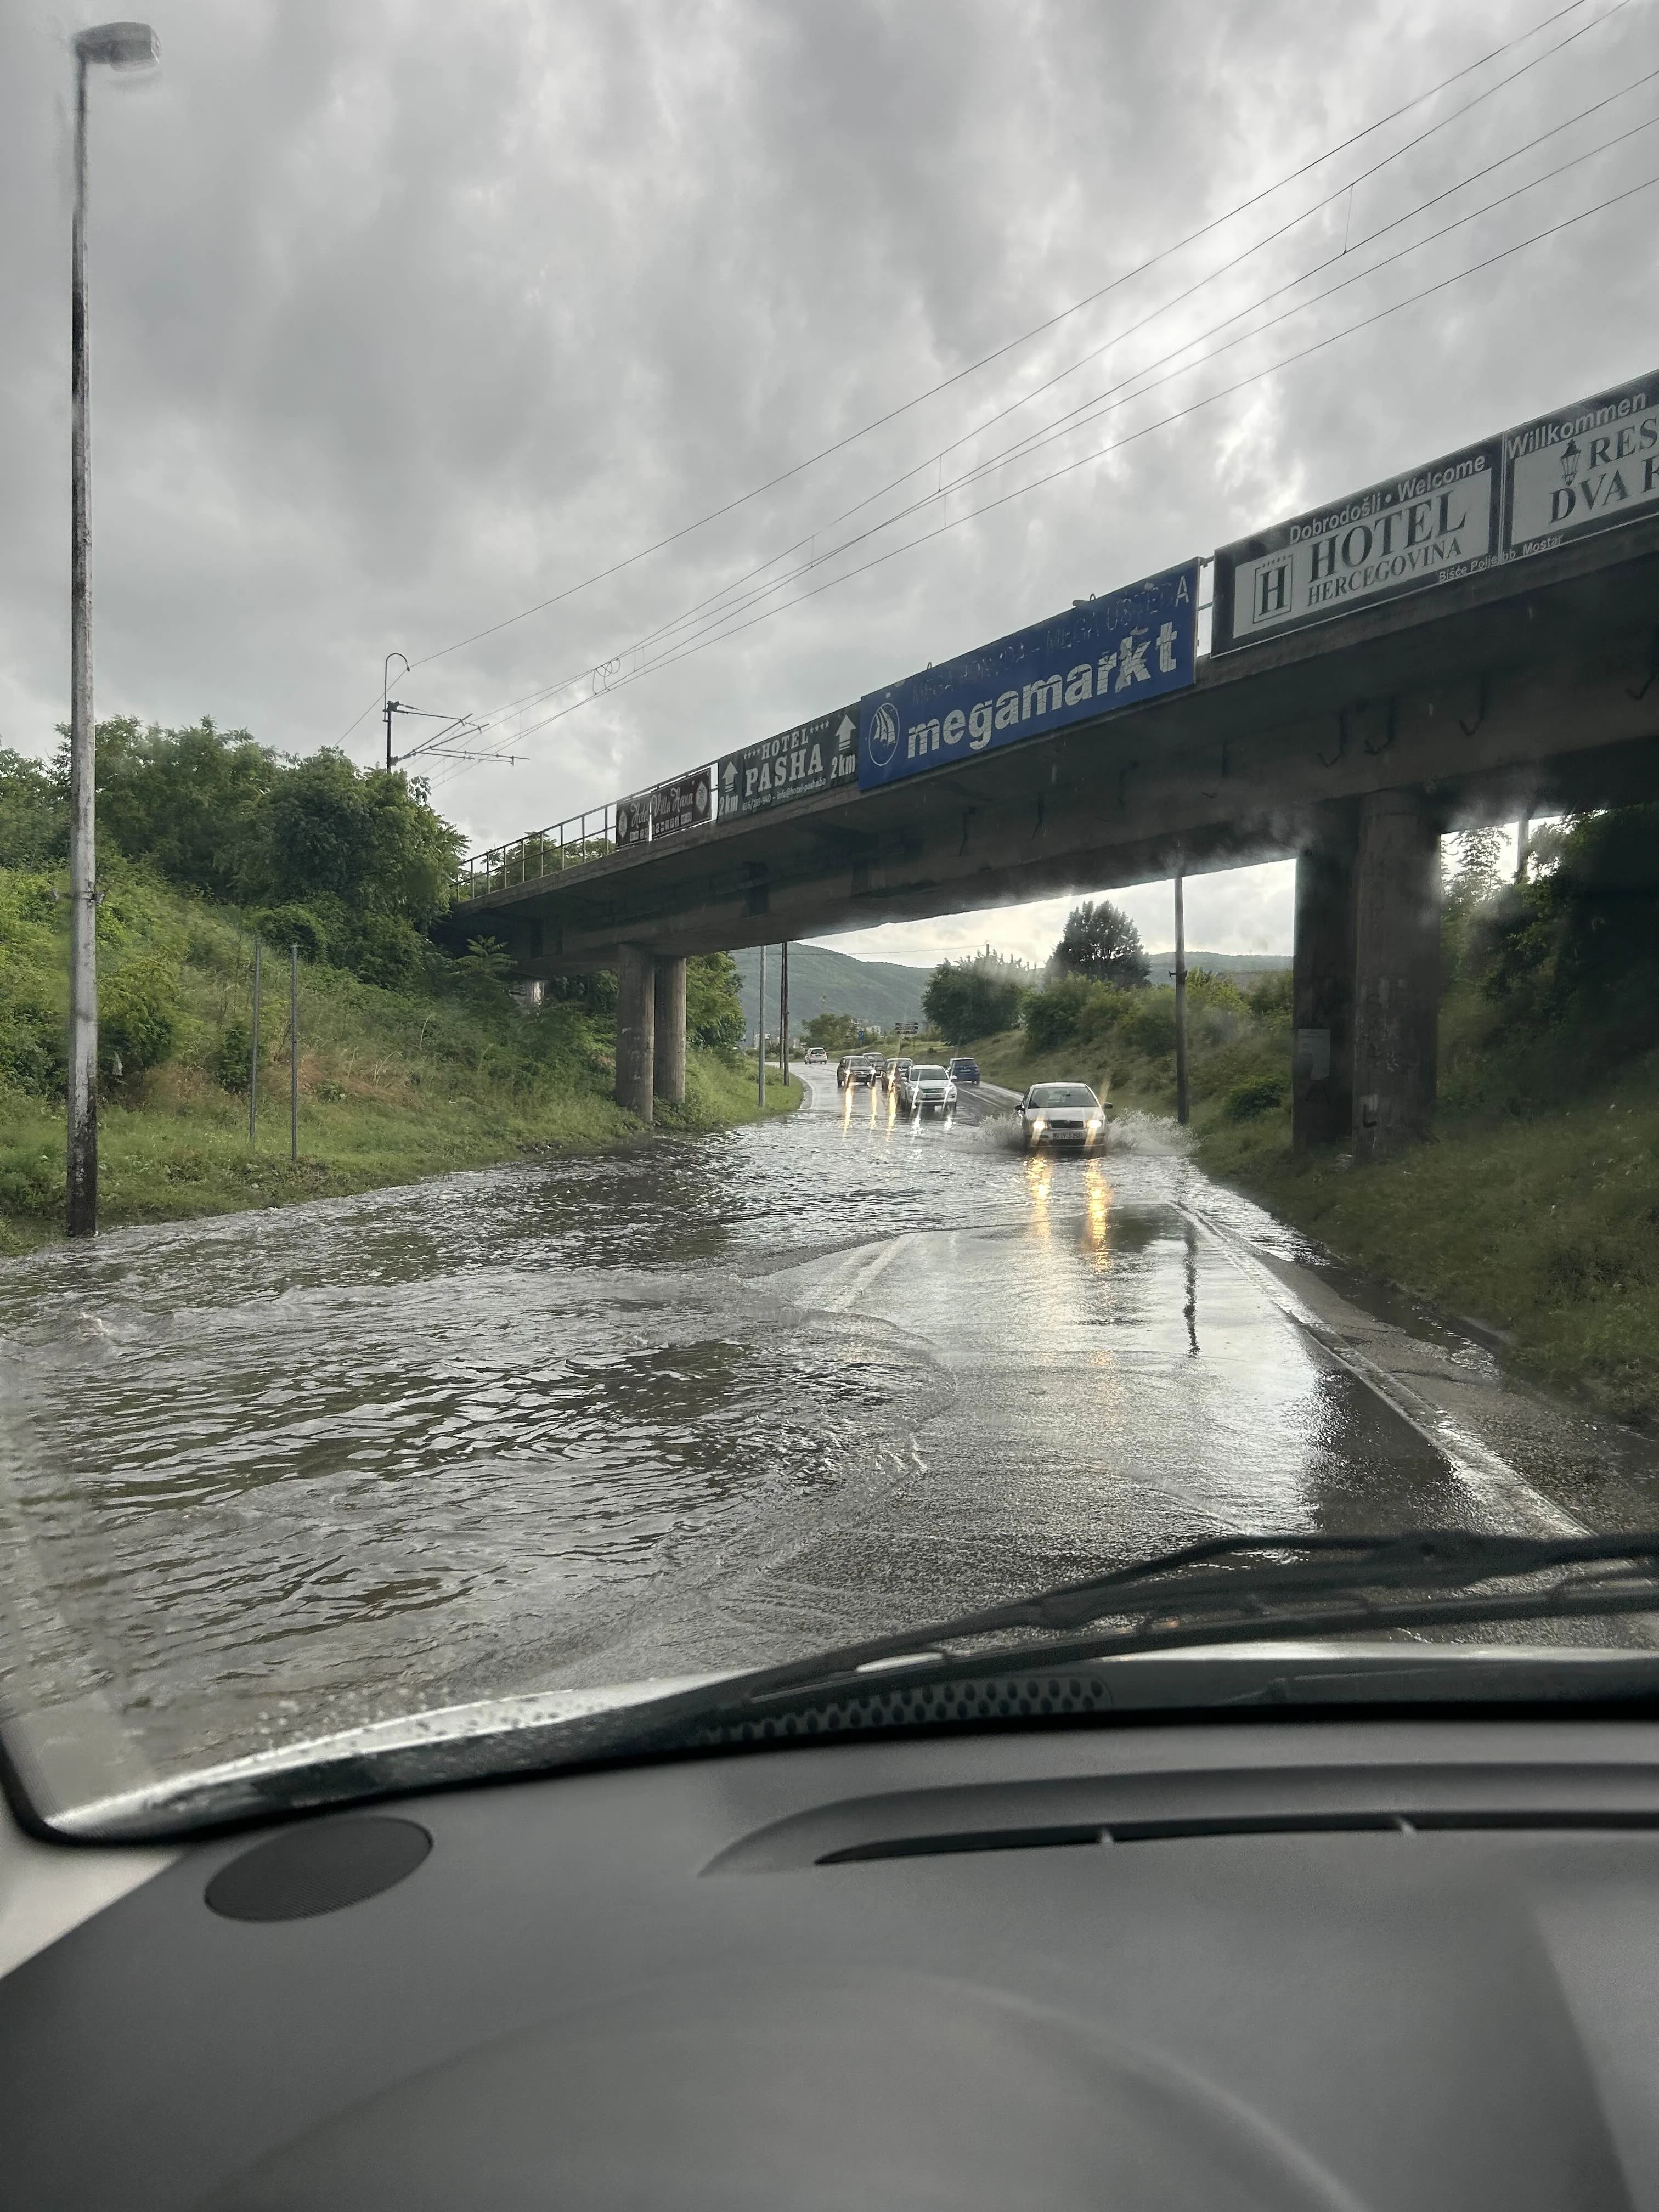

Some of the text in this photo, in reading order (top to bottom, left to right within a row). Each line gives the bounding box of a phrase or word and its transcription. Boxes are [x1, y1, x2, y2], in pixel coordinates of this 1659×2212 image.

[1506, 392, 1646, 460] Willkommen
[1290, 455, 1485, 545] Dobrodošli Welcome
[1549, 469, 1630, 524] DVA
[1307, 490, 1467, 584] HOTEL
[1470, 555, 1498, 572] Polje
[1523, 534, 1564, 556] Mostar
[1307, 537, 1463, 607] HERCEGOVINA
[907, 622, 1177, 758] megamarkt
[745, 744, 823, 797] PASHA
[761, 728, 809, 760] HOTEL
